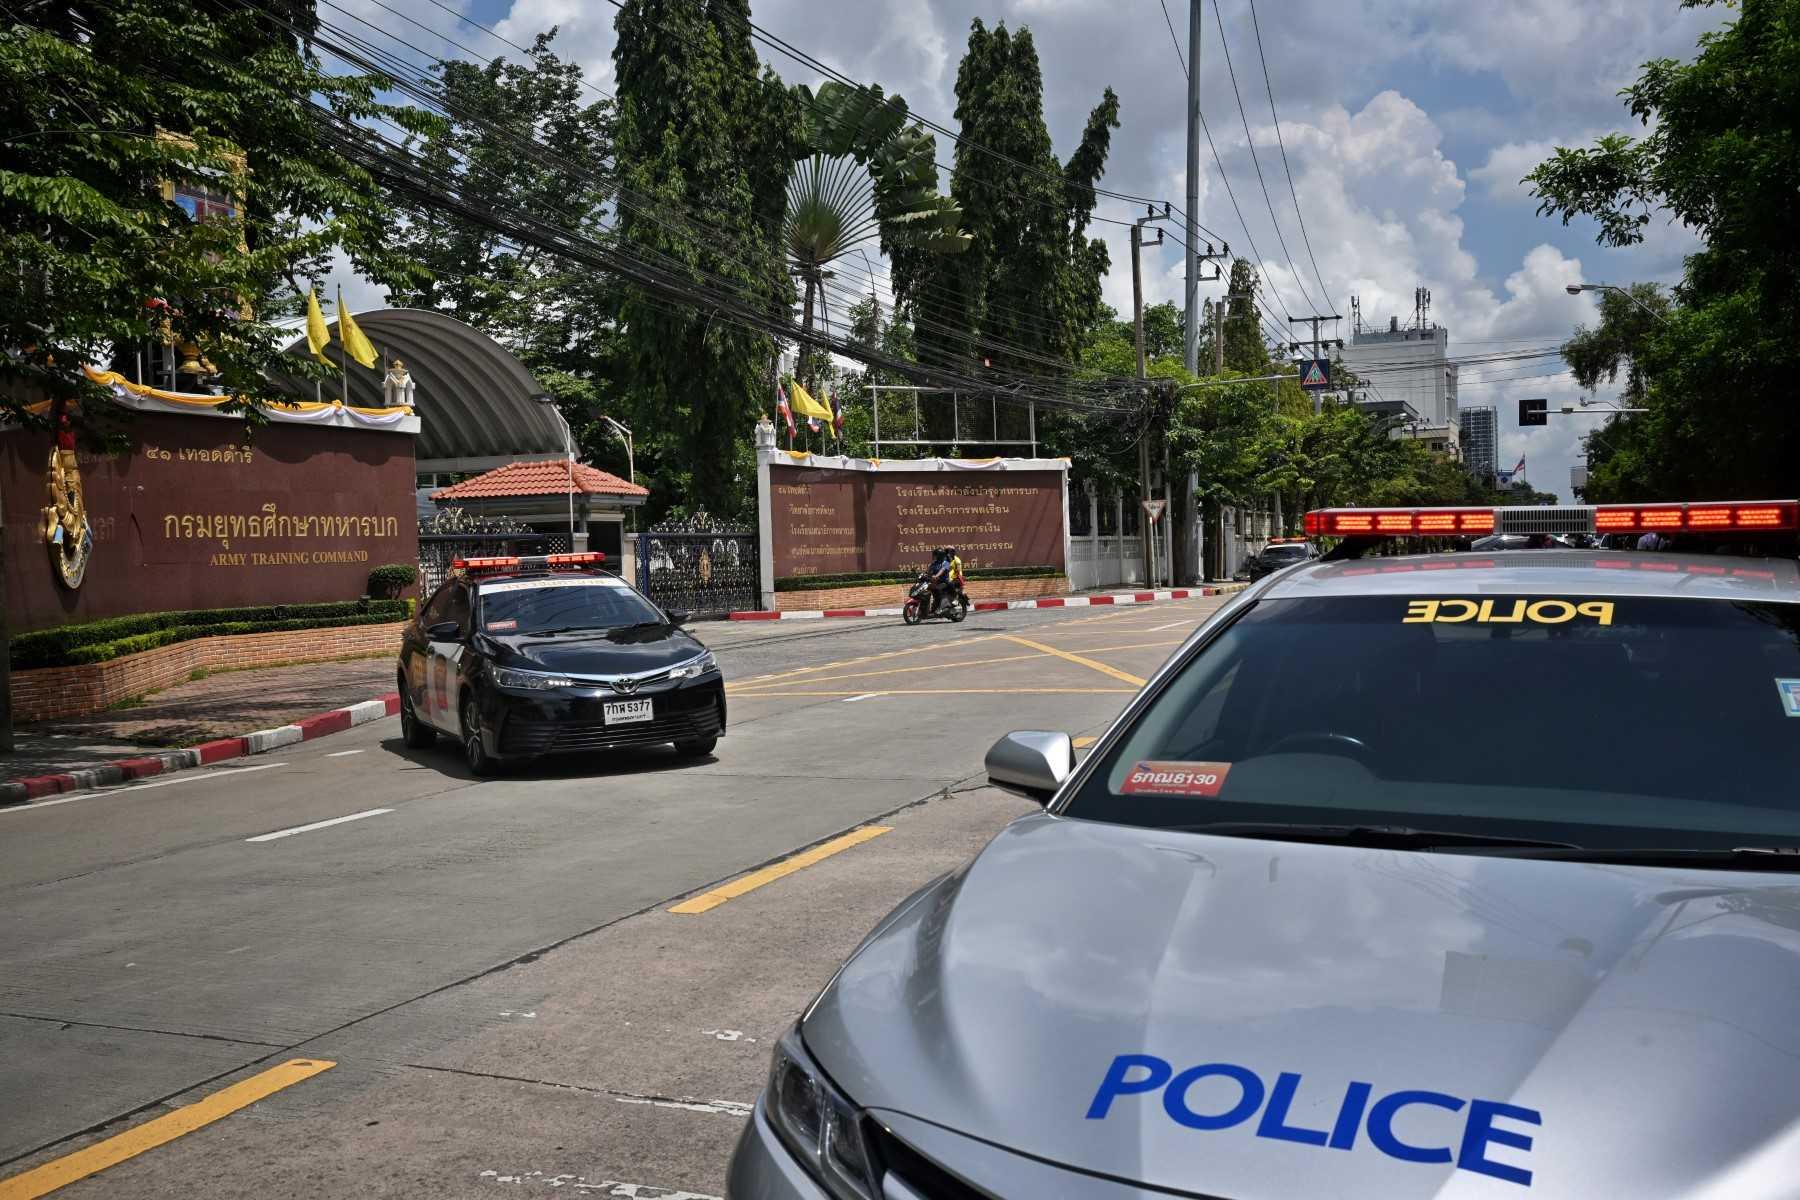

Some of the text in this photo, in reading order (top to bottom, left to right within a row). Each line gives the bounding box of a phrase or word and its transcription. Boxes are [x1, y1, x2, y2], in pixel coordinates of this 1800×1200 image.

[179, 443, 255, 464] เทอดดำริ
[164, 502, 399, 550] กรมยุทธศึกษาทหารบก
[896, 522, 1001, 536] โรงเรียนทหารการเงิน
[208, 550, 369, 566] ARMY TRAINING COMMAND
[627, 701, 650, 713] 5377
[1085, 1054, 1542, 1187] POLICE
